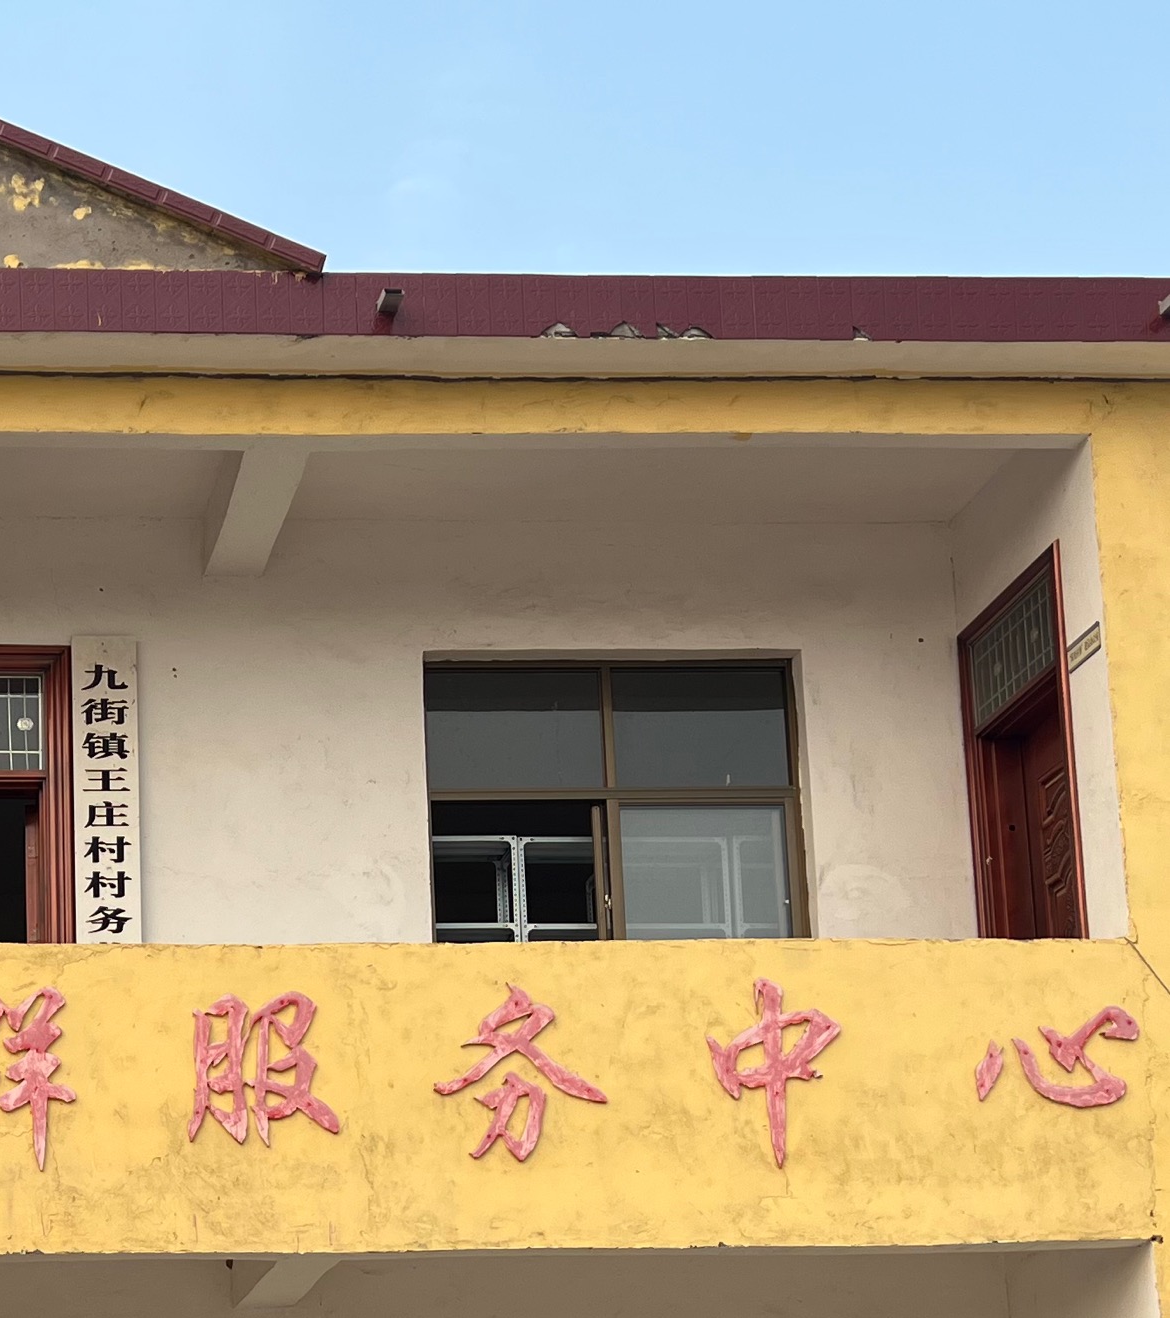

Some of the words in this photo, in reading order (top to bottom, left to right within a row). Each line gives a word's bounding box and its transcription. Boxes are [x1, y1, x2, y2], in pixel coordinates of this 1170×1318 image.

[81, 663, 132, 944] 九街镇王庄村村务
